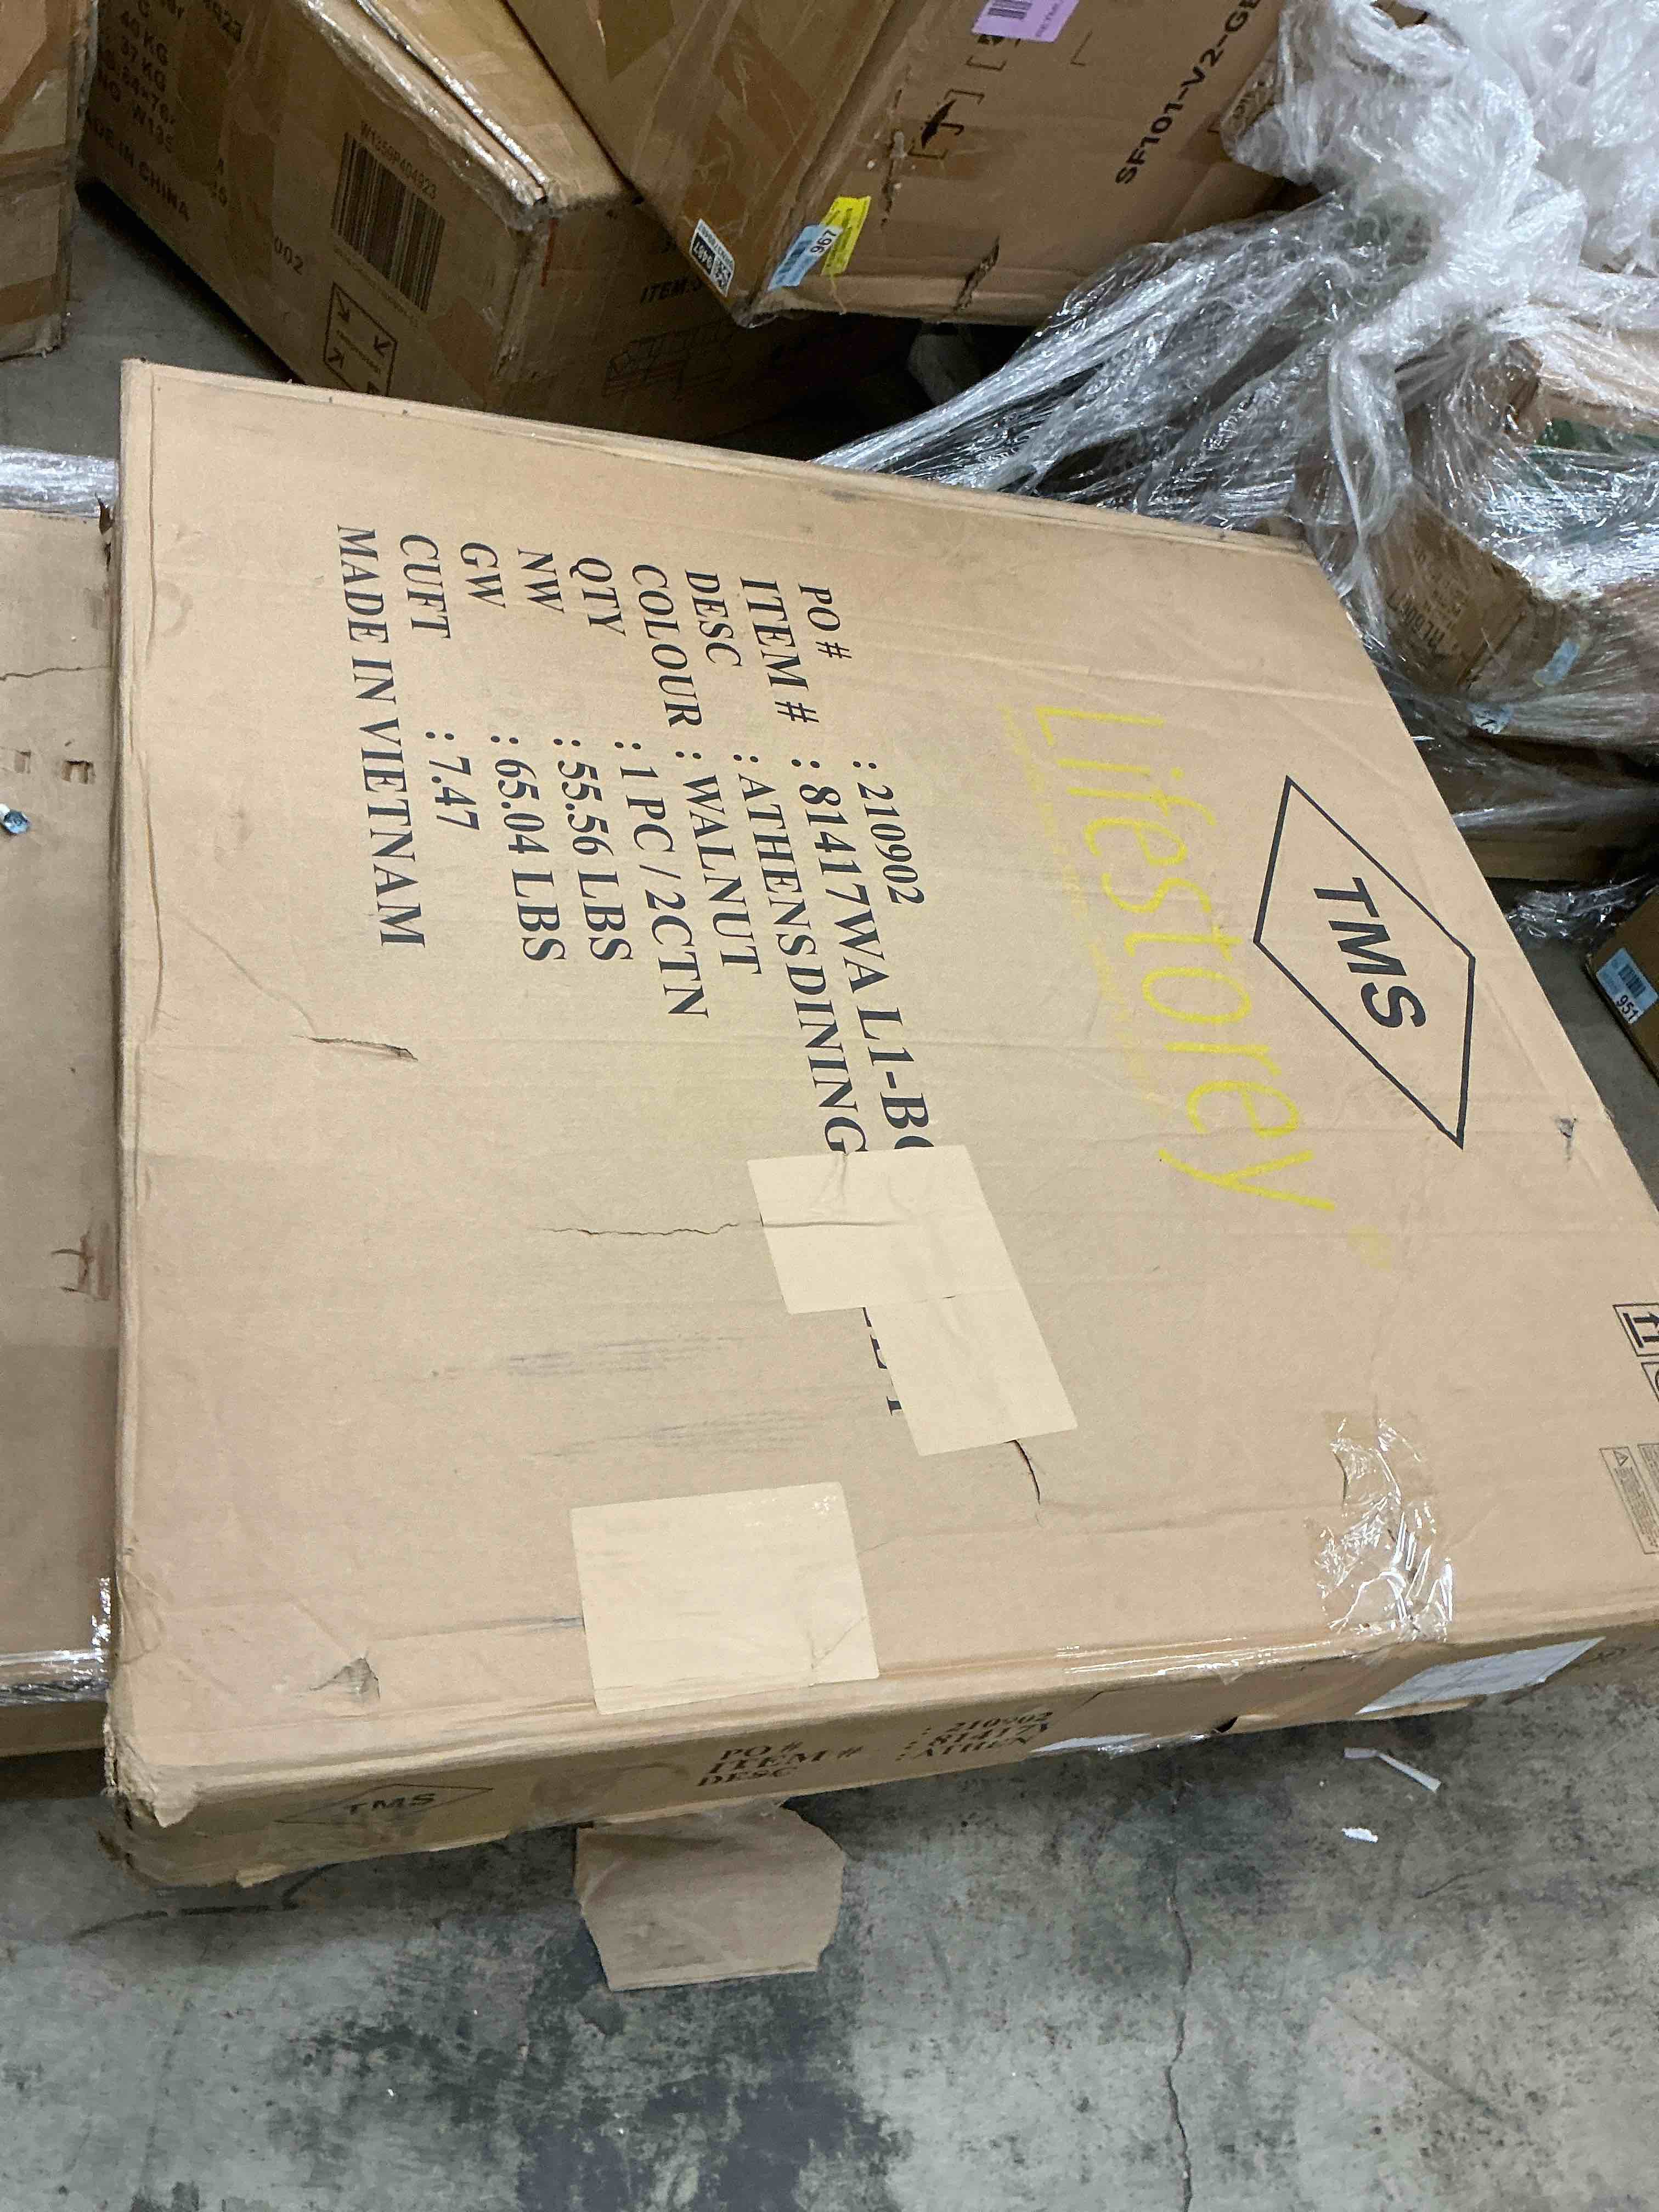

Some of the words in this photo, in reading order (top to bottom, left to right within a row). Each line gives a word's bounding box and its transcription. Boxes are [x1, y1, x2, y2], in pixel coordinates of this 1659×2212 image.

[138, 160, 191, 222] CHINA
[810, 229, 837, 253] 967
[337, 524, 391, 644] MADE
[460, 541, 506, 610] GW
[517, 546, 565, 614] NW
[568, 556, 627, 637] QTY
[684, 568, 743, 667] DESC
[351, 656, 397, 704] IN
[399, 534, 452, 639] CUFT
[428, 756, 481, 832] 7.47
[494, 758, 550, 855] 65.04
[557, 760, 614, 856] 55.56
[631, 563, 703, 727] COLOUR
[682, 773, 763, 975] WALNUT
[358, 717, 427, 948] VIETNAM
[856, 782, 926, 906] 210902
[511, 868, 567, 962] LBS
[577, 868, 634, 962] LBS
[1312, 876, 1427, 1030] TMS
[1616, 994, 1639, 1022] 951
[344, 1793, 437, 1815] TMS
[696, 1765, 799, 1787] DESC
[708, 1749, 830, 1774] ITEM
